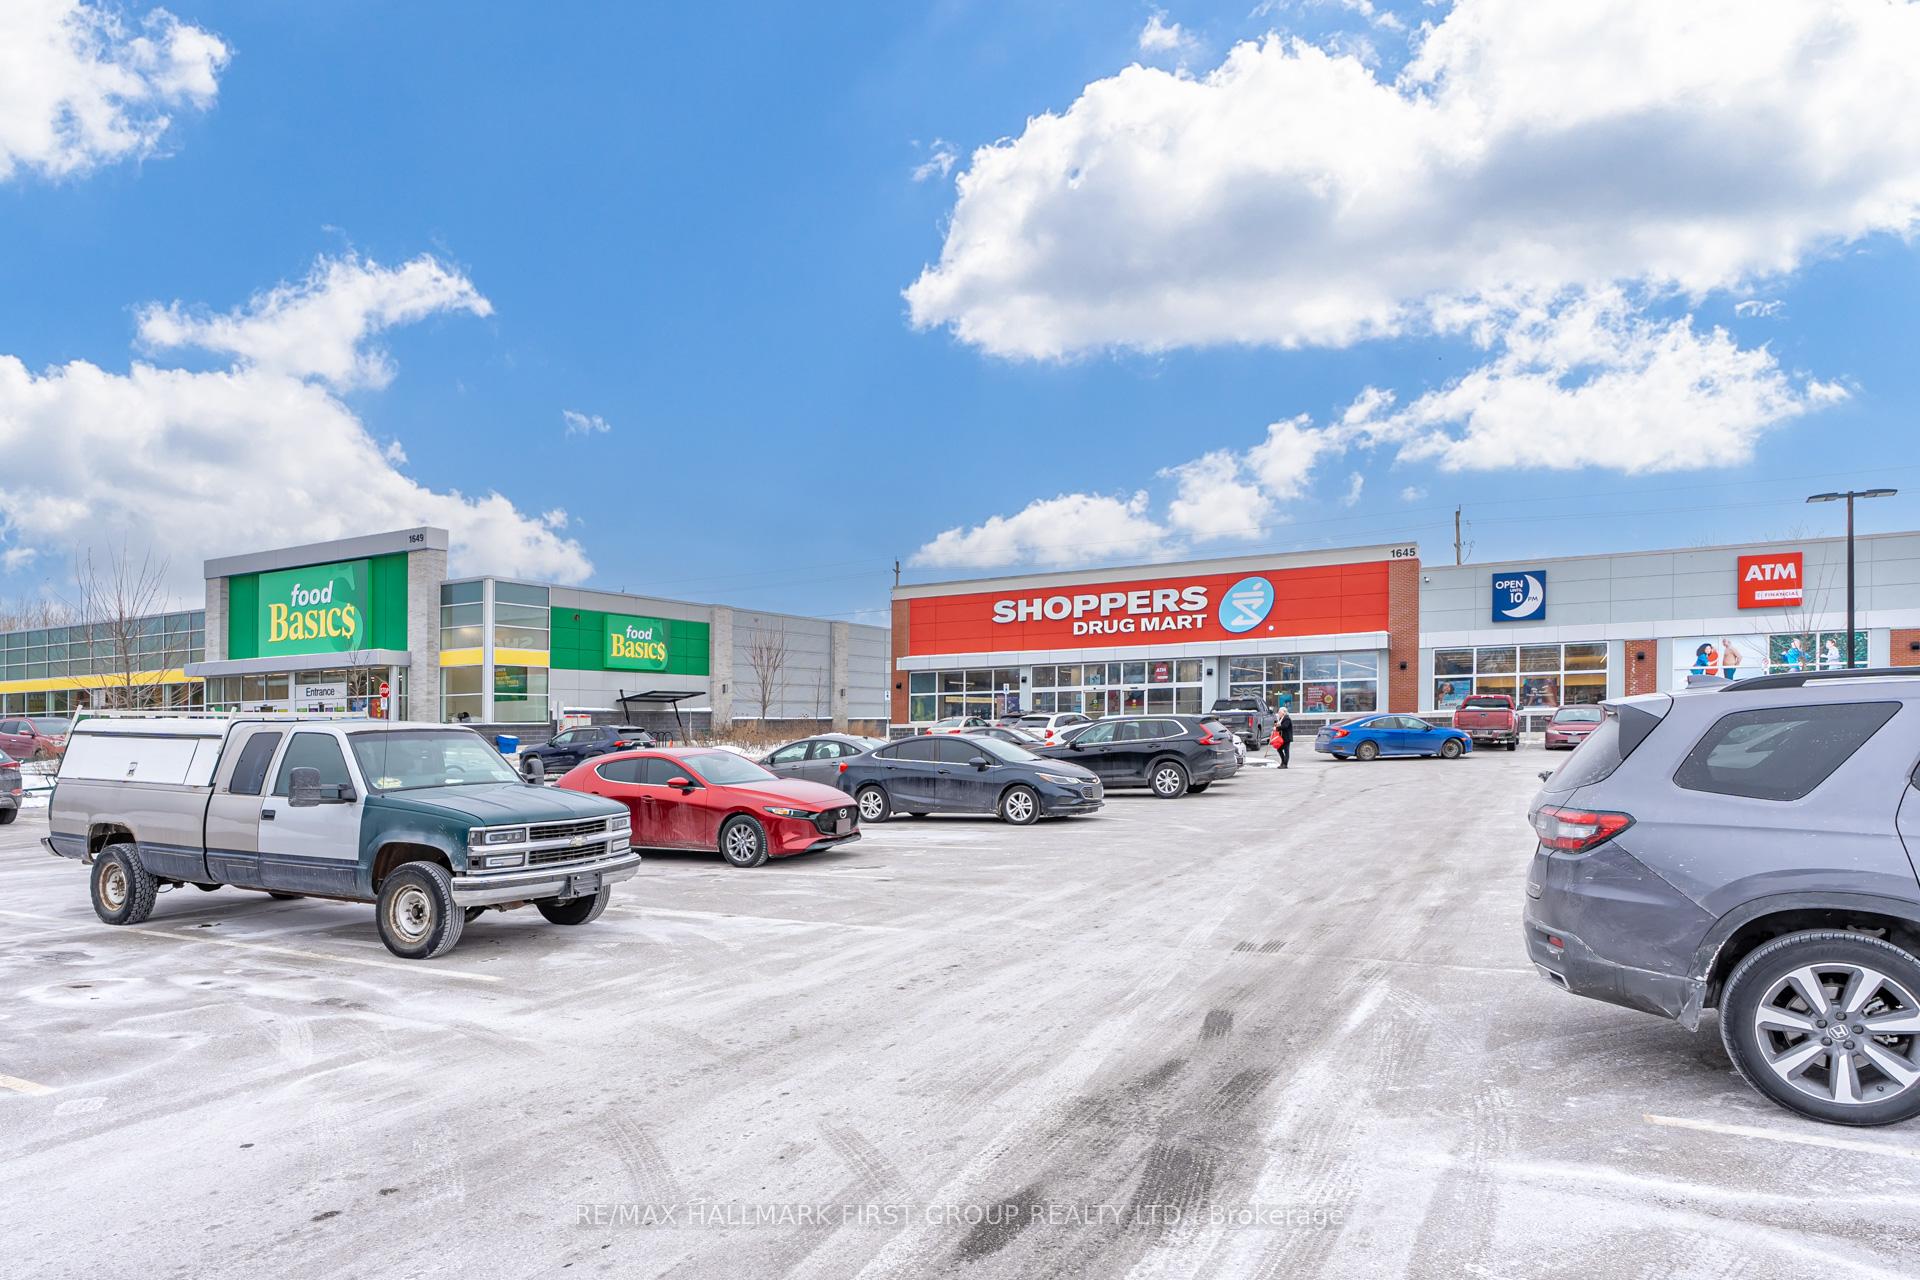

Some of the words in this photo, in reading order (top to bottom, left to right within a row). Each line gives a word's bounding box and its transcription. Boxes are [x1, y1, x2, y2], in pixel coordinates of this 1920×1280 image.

[409, 533, 424, 543] 1649
[1390, 547, 1416, 558] 1645
[1744, 562, 1797, 581] ATM
[1495, 580, 1523, 589] OPEN
[291, 580, 334, 607] food
[1510, 592, 1523, 603] 10
[992, 586, 1209, 624] SHOPPERS
[1073, 619, 1135, 636] DRUG
[1140, 614, 1208, 632] MART
[626, 624, 653, 640] food
[305, 687, 335, 697] Entrance
